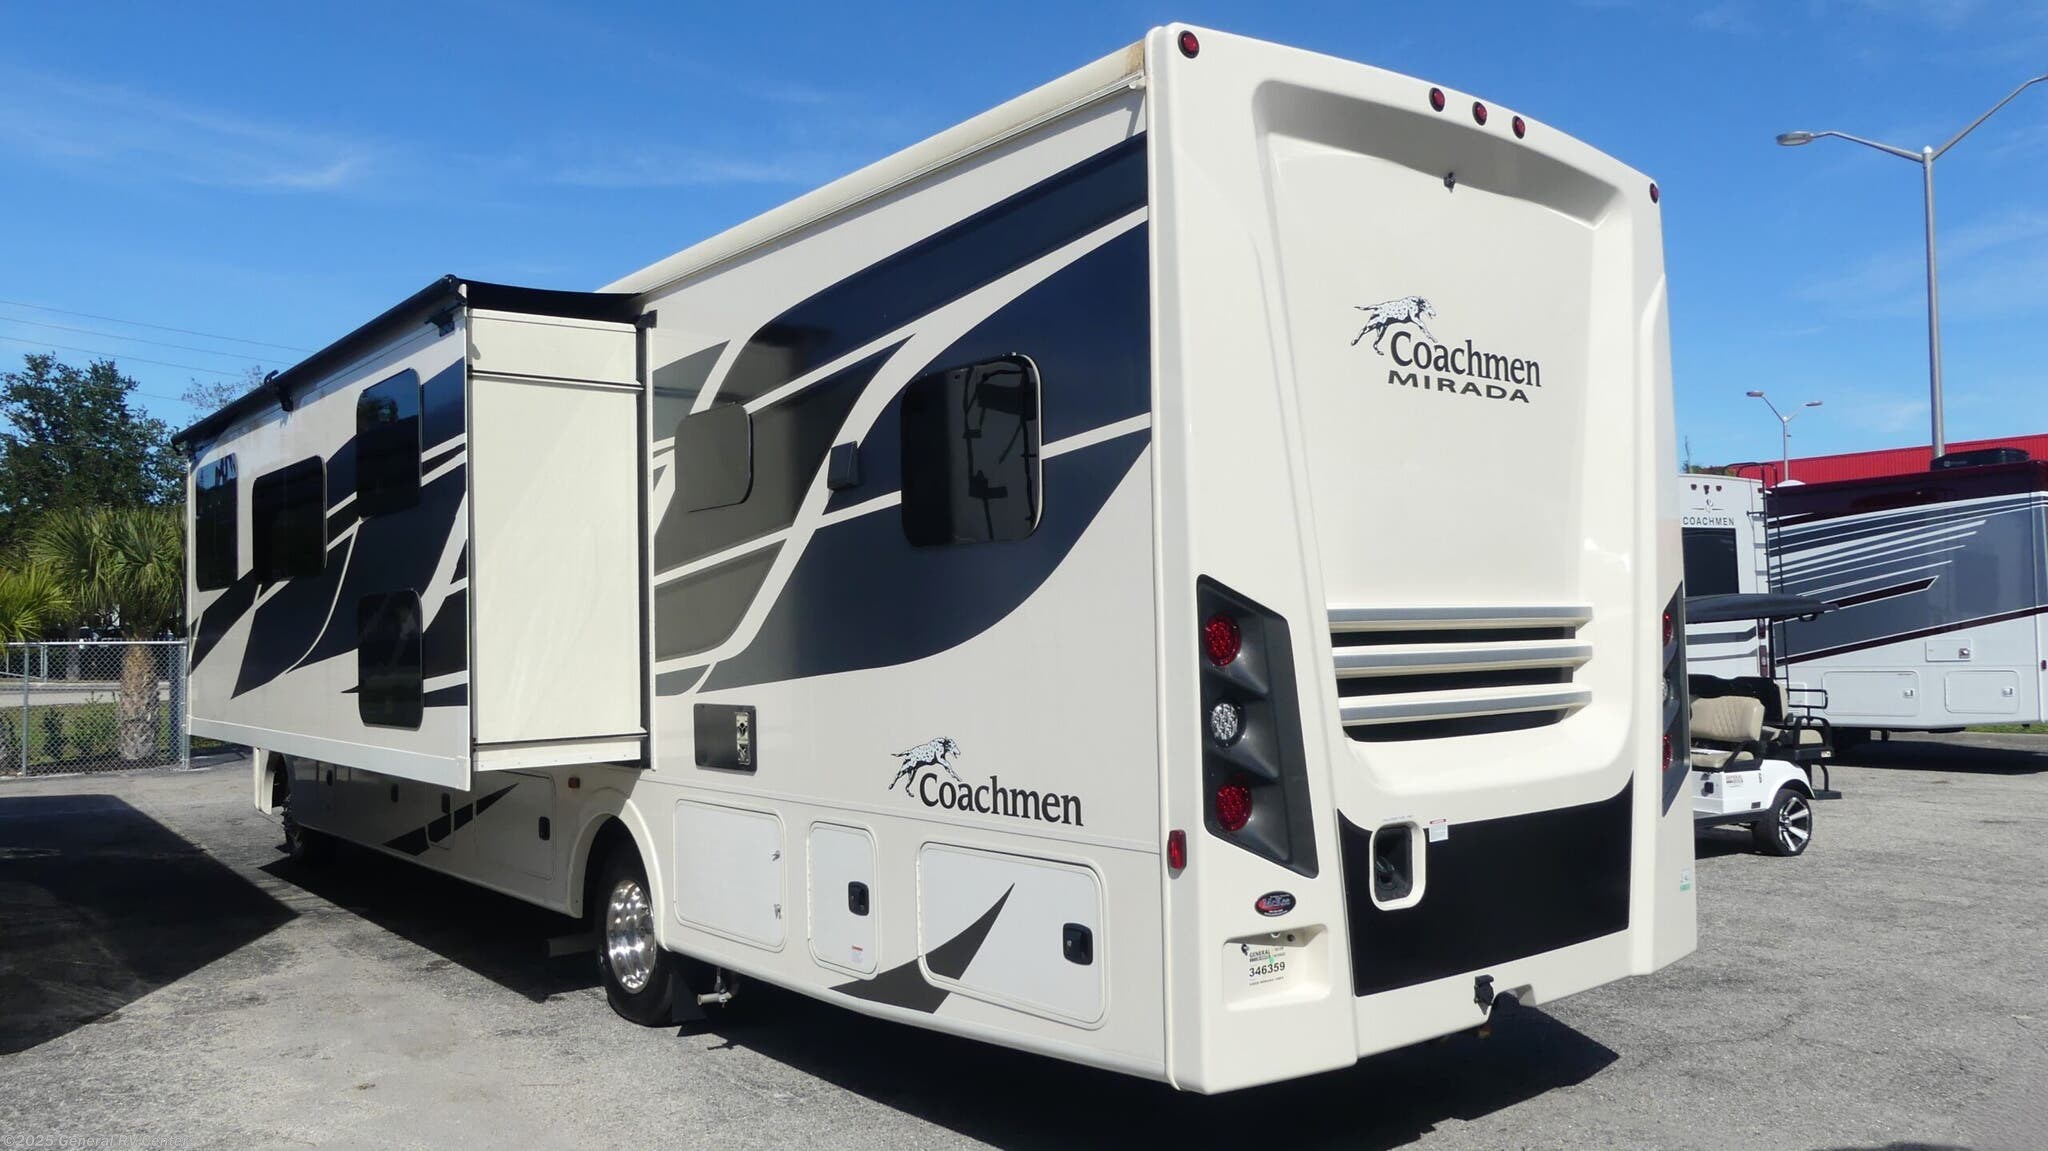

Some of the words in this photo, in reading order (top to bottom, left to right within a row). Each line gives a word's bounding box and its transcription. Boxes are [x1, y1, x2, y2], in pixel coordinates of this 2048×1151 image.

[1390, 331, 1542, 387] Coachmen
[1388, 370, 1530, 403] MIRADA
[1682, 516, 1735, 526] COACHMEN
[919, 772, 1084, 826] Coachmen
[1249, 961, 1286, 977] 346359
